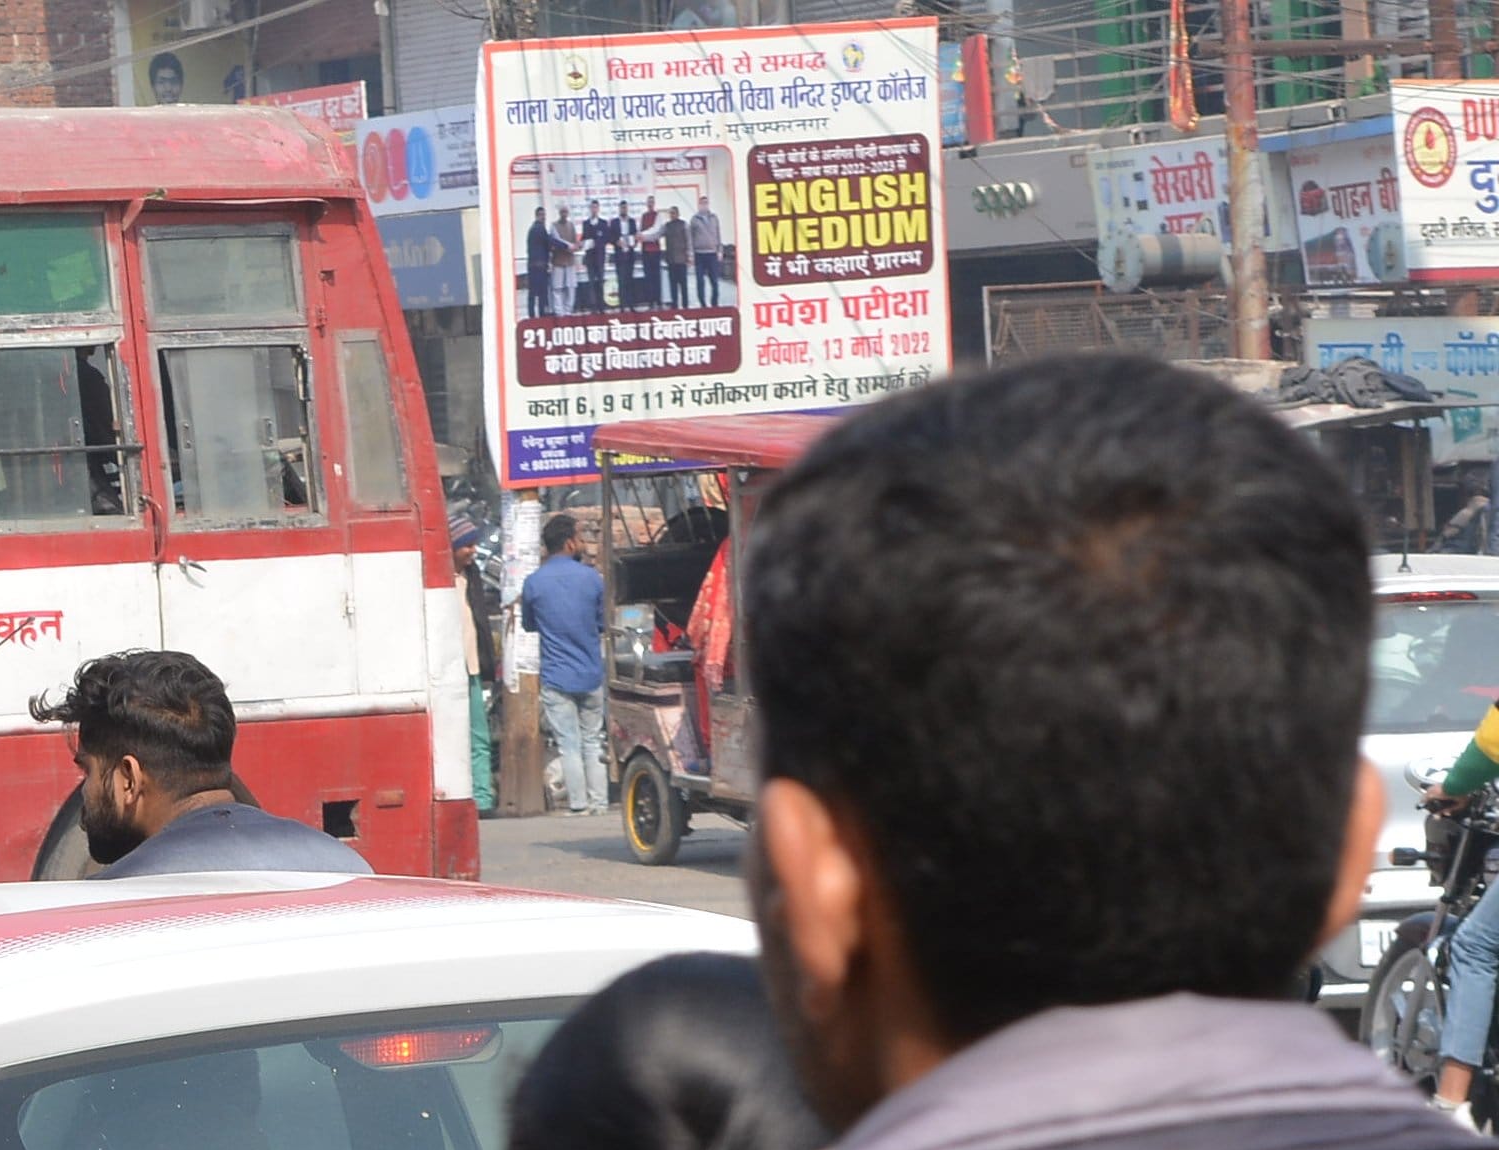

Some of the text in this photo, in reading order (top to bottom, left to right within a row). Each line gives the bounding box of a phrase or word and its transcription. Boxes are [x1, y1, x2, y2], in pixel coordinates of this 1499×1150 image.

[607, 58, 654, 81] विद्या
[663, 53, 724, 78] भारती
[732, 51, 752, 74] से
[506, 99, 548, 125] लाला
[554, 88, 617, 122] जगदीश
[622, 93, 666, 120] प्रसाद
[672, 81, 734, 116] सरस्वती
[739, 79, 774, 112] विद्या
[780, 76, 826, 109] मन्दिर
[877, 69, 927, 101] कॉलेज
[755, 172, 926, 217] ENGLISH
[757, 209, 928, 255] MEDIUM
[764, 256, 782, 277] में
[786, 254, 810, 275] भी
[753, 285, 930, 330] प्रवेश परीक्षा
[523, 326, 585, 350] 21,000
[587, 325, 608, 344] का
[666, 343, 681, 365] के
[823, 338, 843, 360] 13
[851, 328, 884, 358] मार्च
[890, 332, 930, 357] 2022
[527, 399, 569, 418] कक्षा
[604, 394, 614, 413] 9
[622, 393, 633, 411] व
[643, 391, 663, 409] 11
[671, 383, 687, 407] में
[691, 381, 768, 406] पंजीकरण
[773, 375, 818, 400] कराने
[823, 373, 851, 402] हेतु
